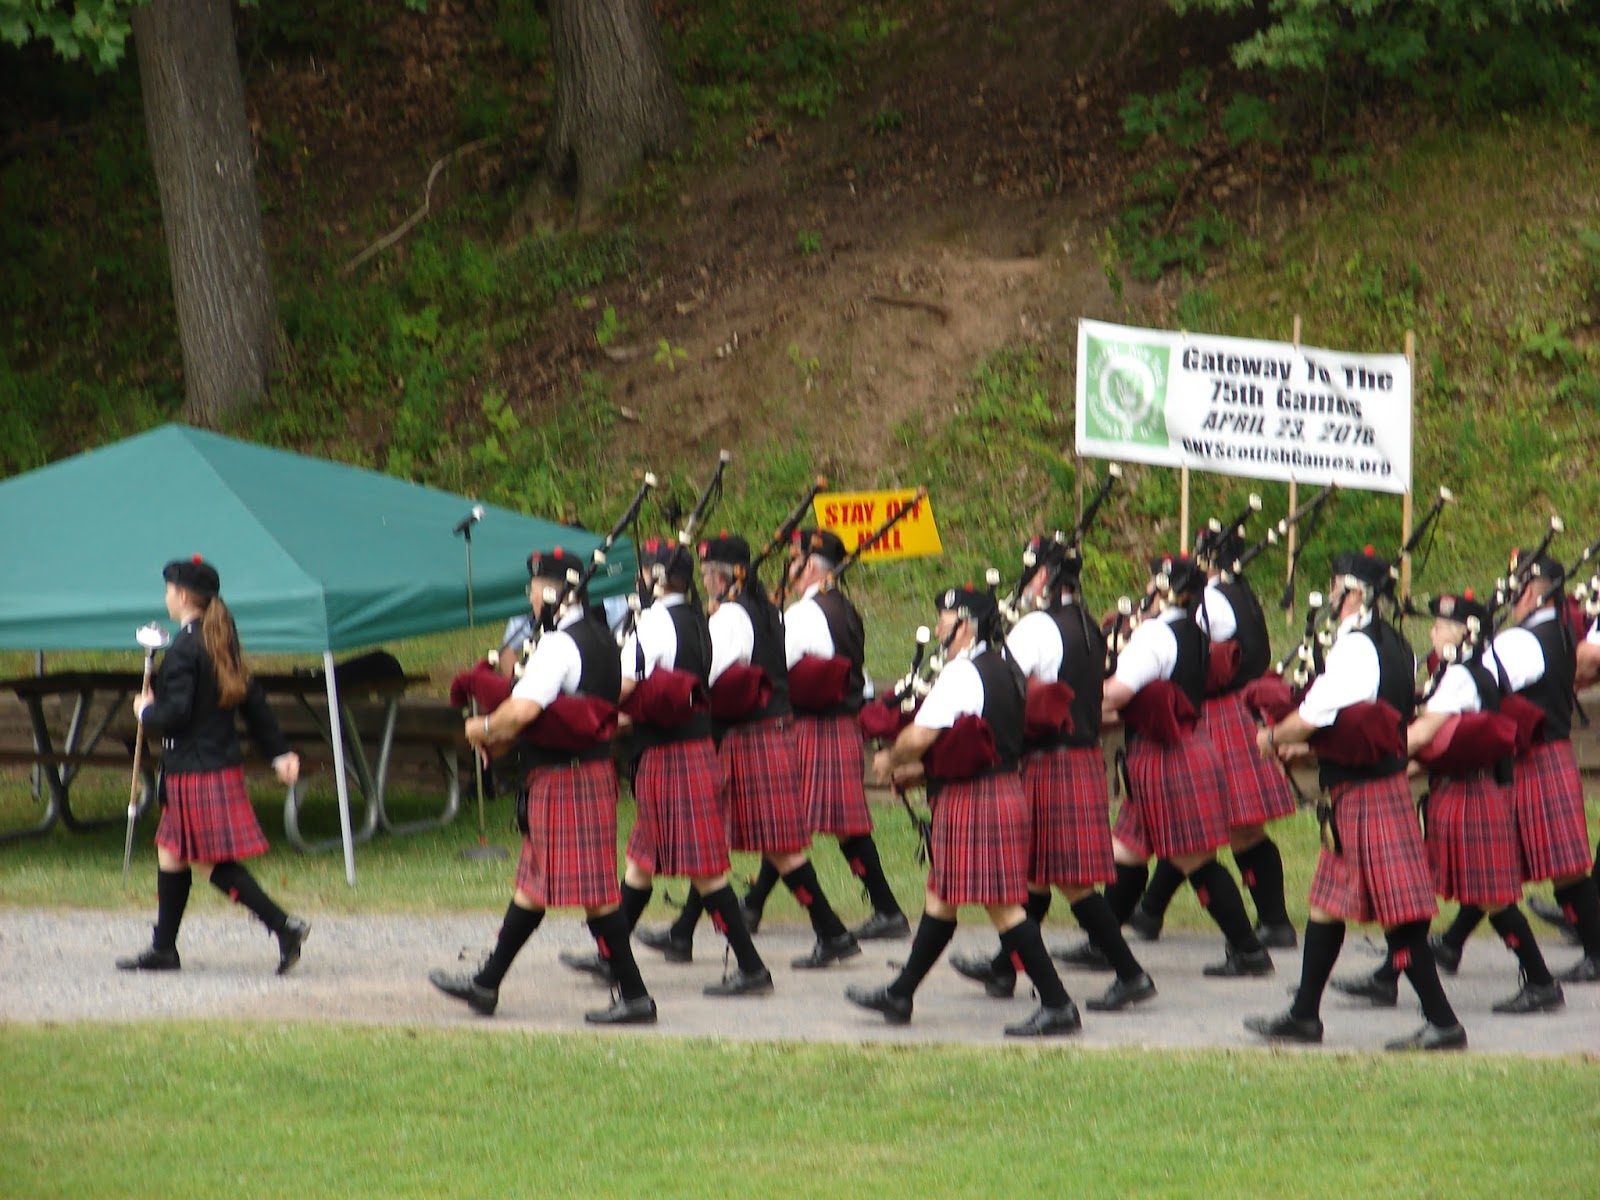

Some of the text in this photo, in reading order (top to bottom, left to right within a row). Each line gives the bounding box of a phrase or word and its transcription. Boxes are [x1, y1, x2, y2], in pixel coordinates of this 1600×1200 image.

[1183, 346, 1291, 380] Gateway
[1305, 358, 1331, 383] To
[1342, 365, 1393, 391] The
[1210, 378, 1362, 419] 75th Games
[1202, 410, 1264, 435] APRIL
[825, 500, 874, 527] STAY
